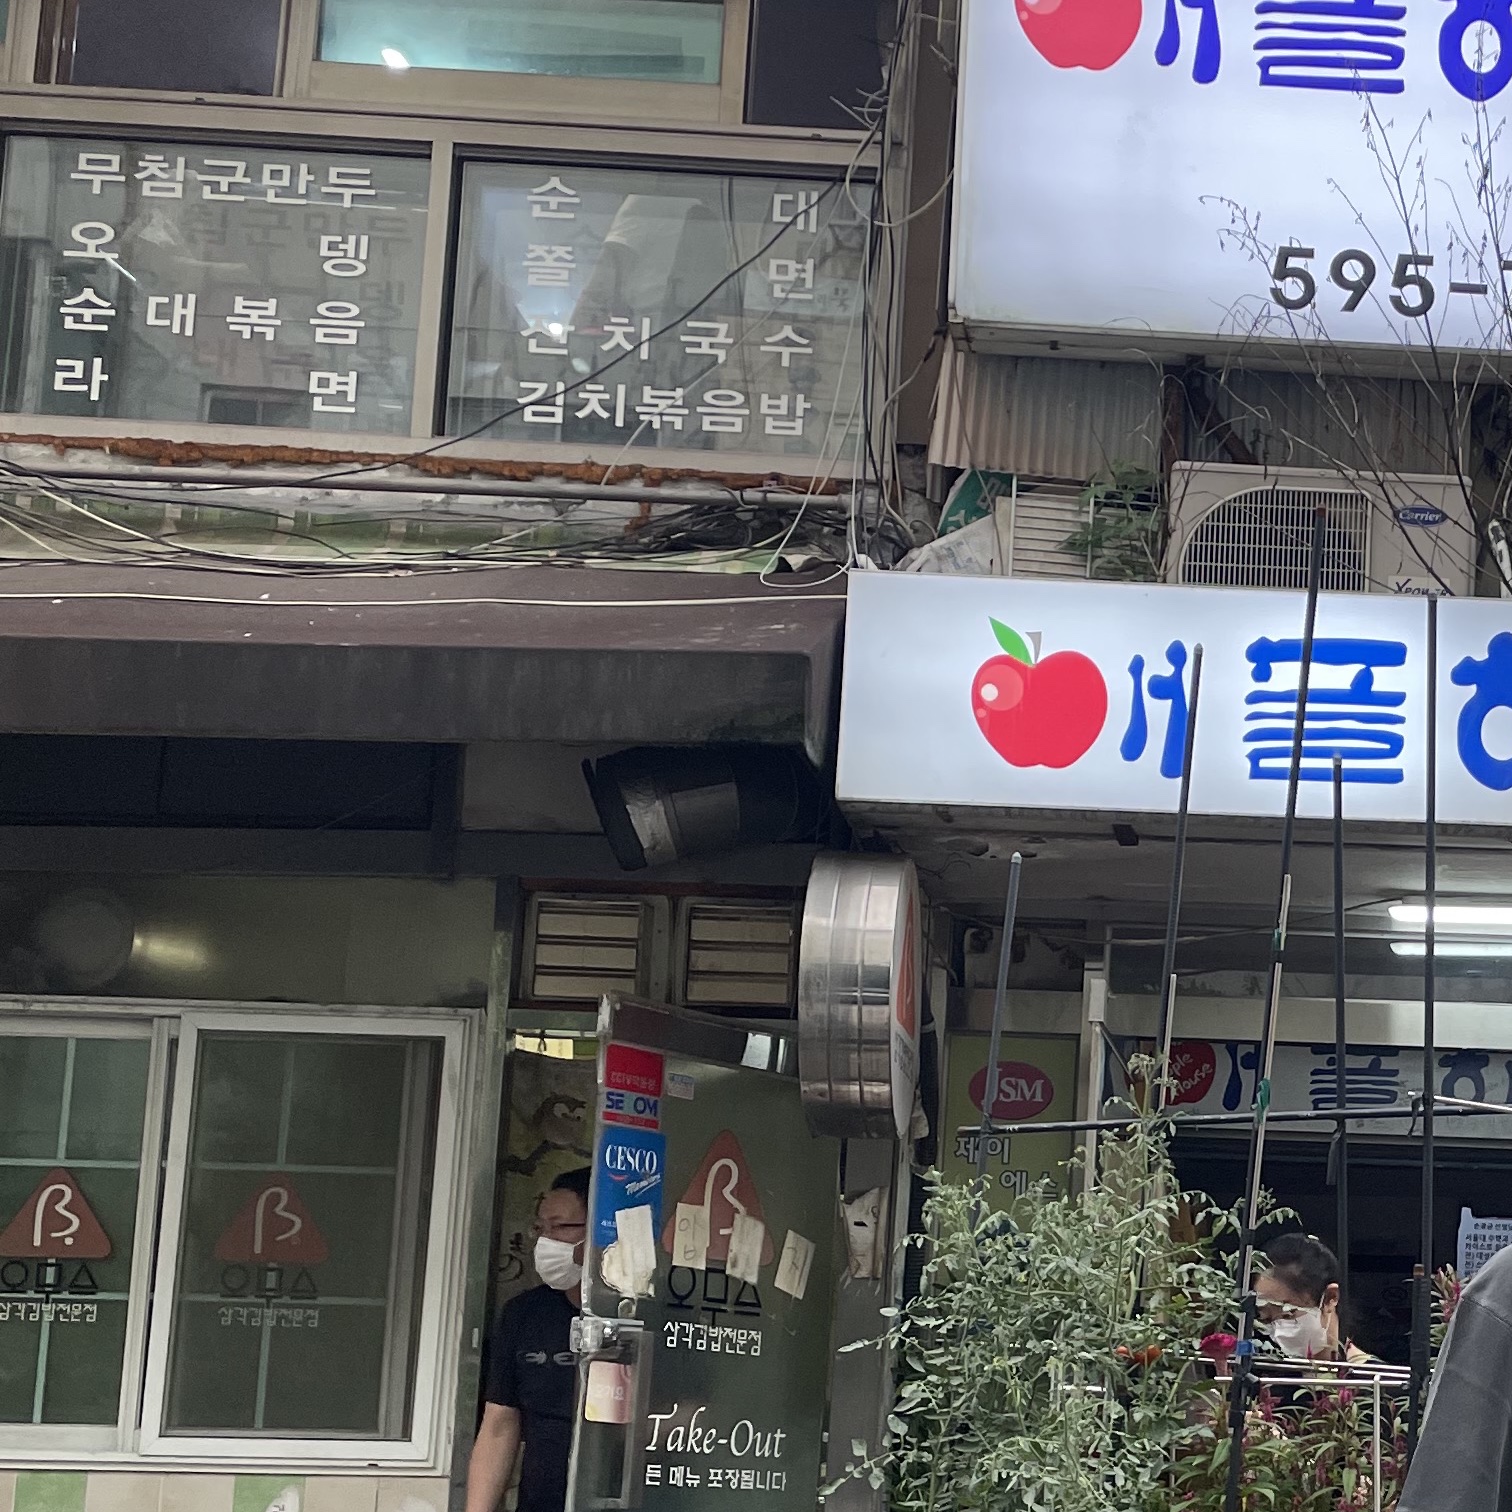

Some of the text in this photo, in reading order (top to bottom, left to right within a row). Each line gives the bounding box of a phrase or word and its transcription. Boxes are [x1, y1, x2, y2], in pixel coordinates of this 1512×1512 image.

[71, 153, 375, 207] 무침군만두
[517, 381, 812, 436] 김치볶음밥
[1399, 511, 1442, 521] Carrier
[605, 1091, 657, 1118] SEOM
[605, 1144, 658, 1173] CESCO
[663, 1321, 762, 1356] 삼각김밥전문점
[645, 1403, 786, 1458] Take-Out
[669, 1466, 700, 1488] 메뉴
[707, 1468, 787, 1491] 포장됩니다
